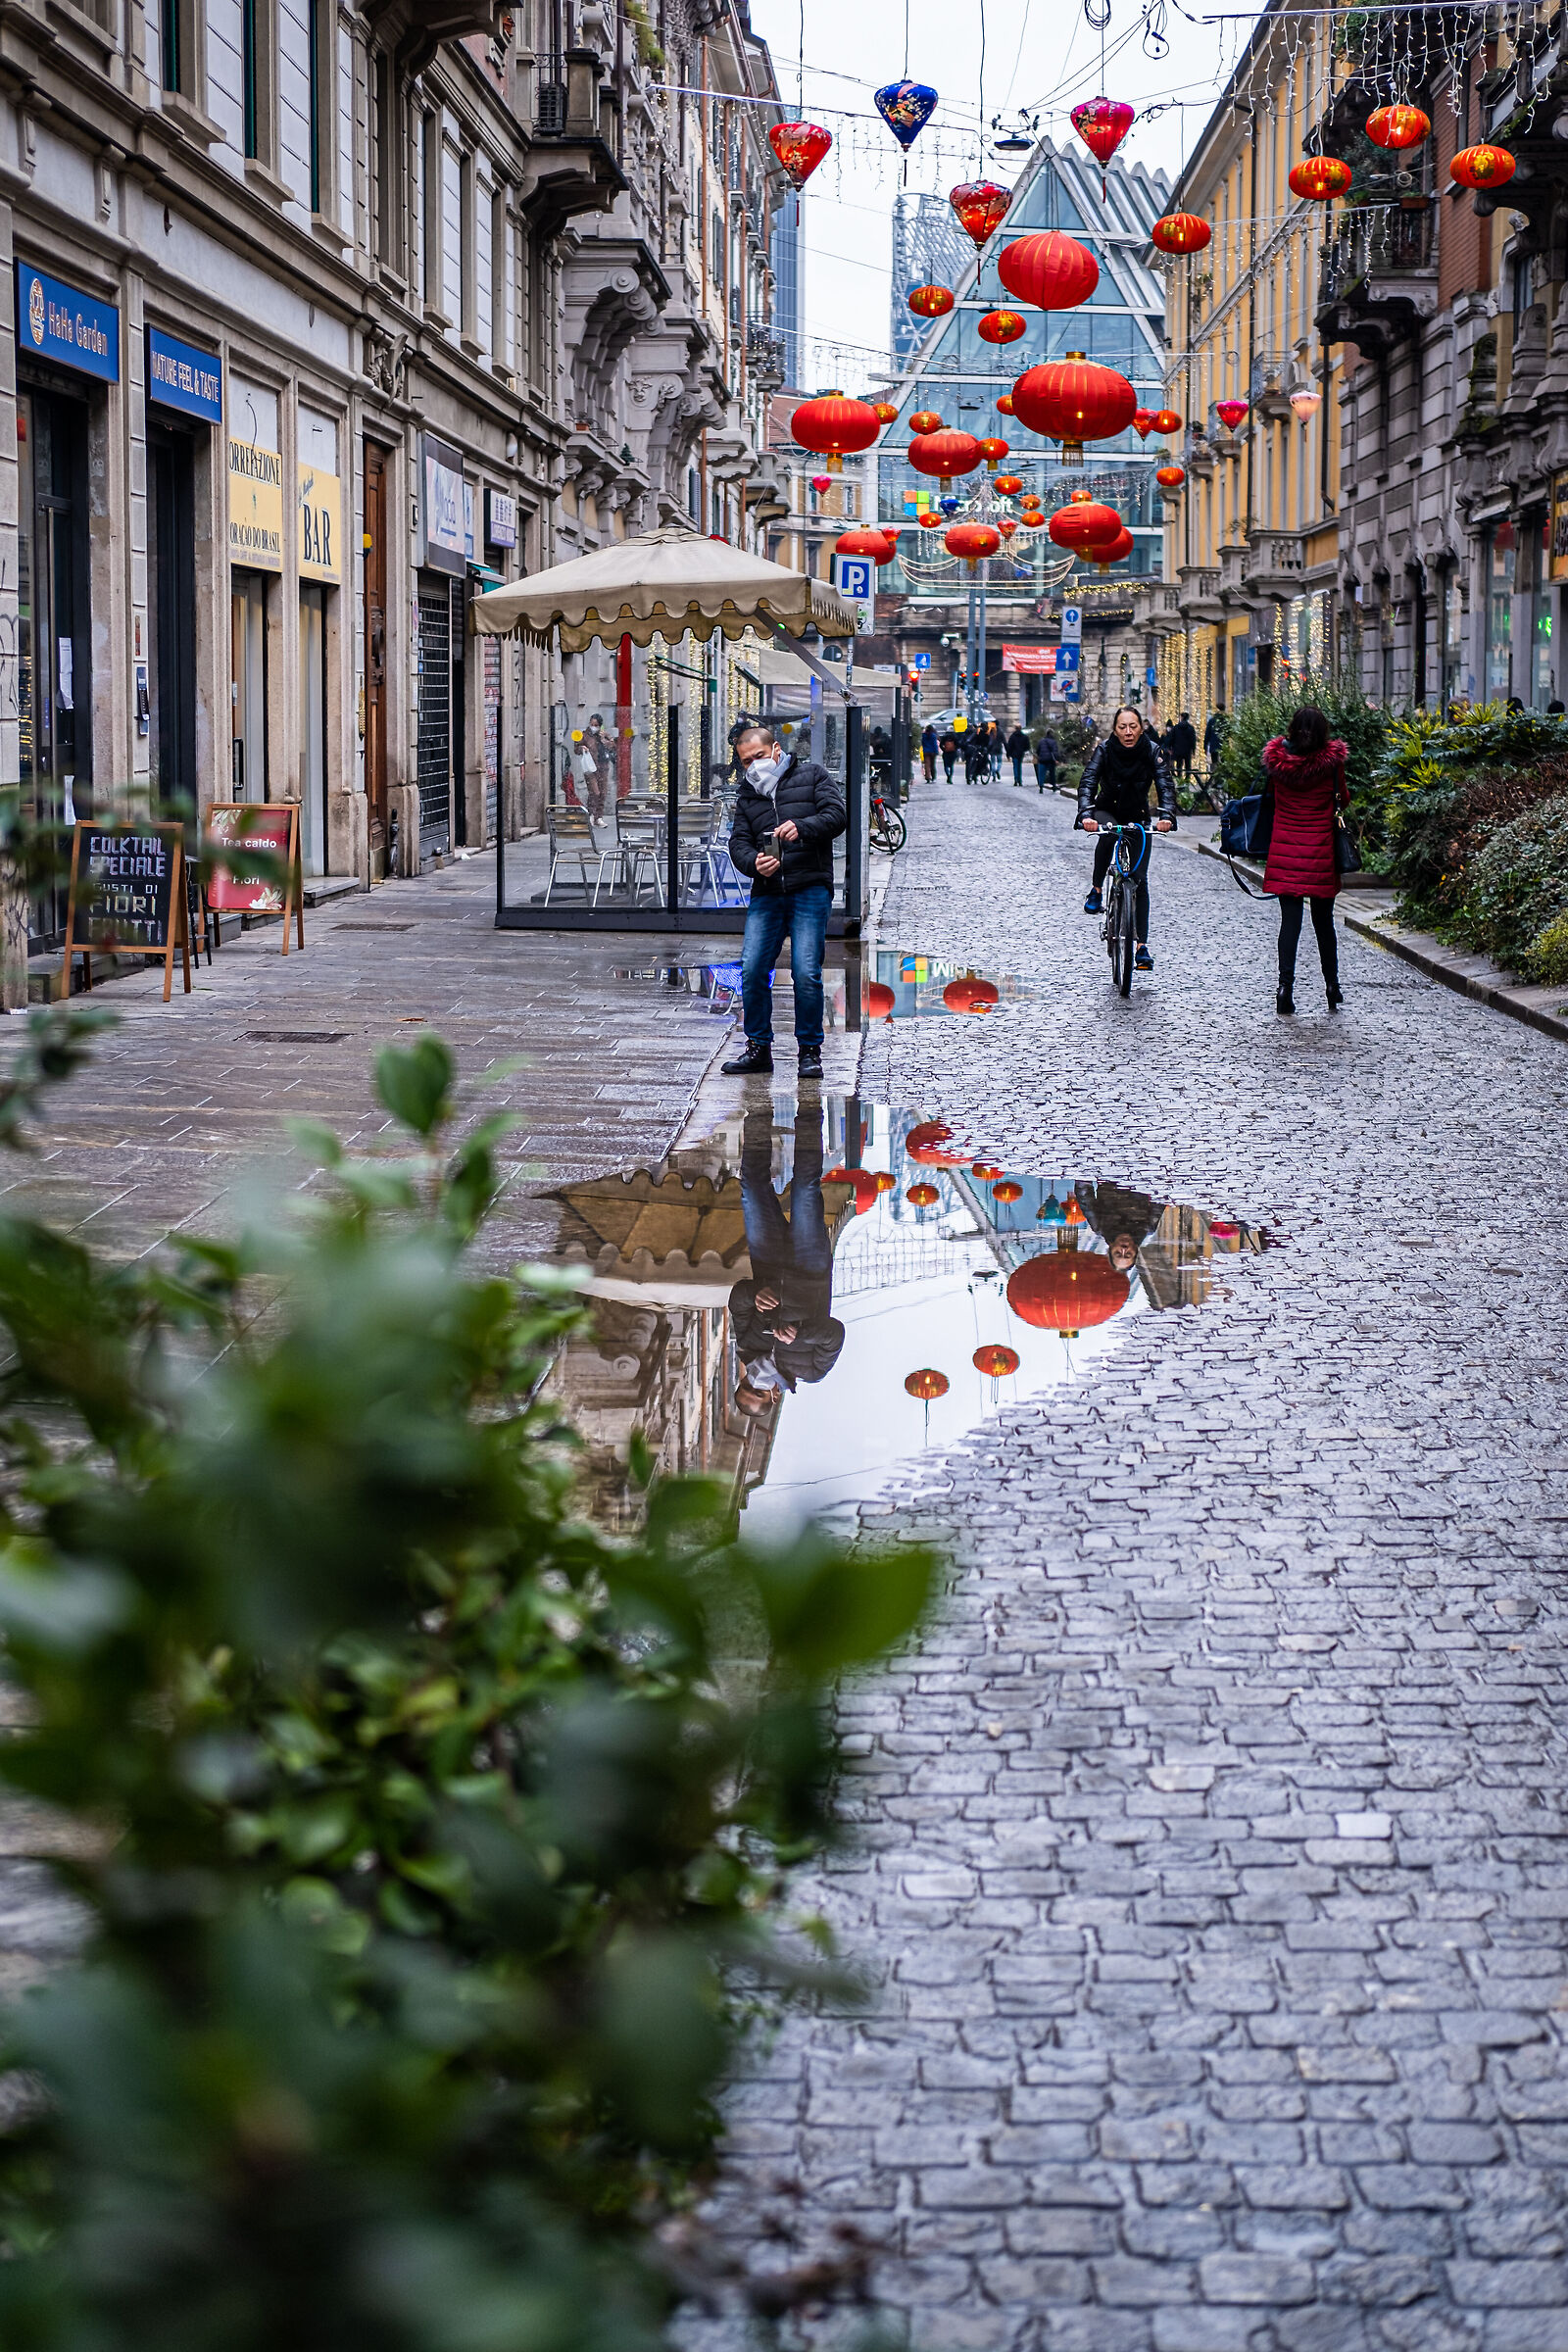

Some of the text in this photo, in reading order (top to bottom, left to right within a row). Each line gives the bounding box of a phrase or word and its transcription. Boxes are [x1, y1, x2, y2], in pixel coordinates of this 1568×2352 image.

[48, 301, 108, 357] HaHa Garden
[152, 351, 220, 403] NATURE FEEL & TASTE
[229, 441, 281, 486] ORREFAZIONE
[933, 495, 1014, 514] Mcrooft
[252, 526, 262, 548] DO
[262, 528, 281, 553] BRASIL
[302, 503, 332, 566] BAR
[90, 837, 167, 857] COCKTAIL
[221, 837, 277, 849] Tea caldo
[89, 856, 166, 878] SPECIALE
[93, 882, 133, 894] GUSTI
[89, 895, 157, 916] FIORI
